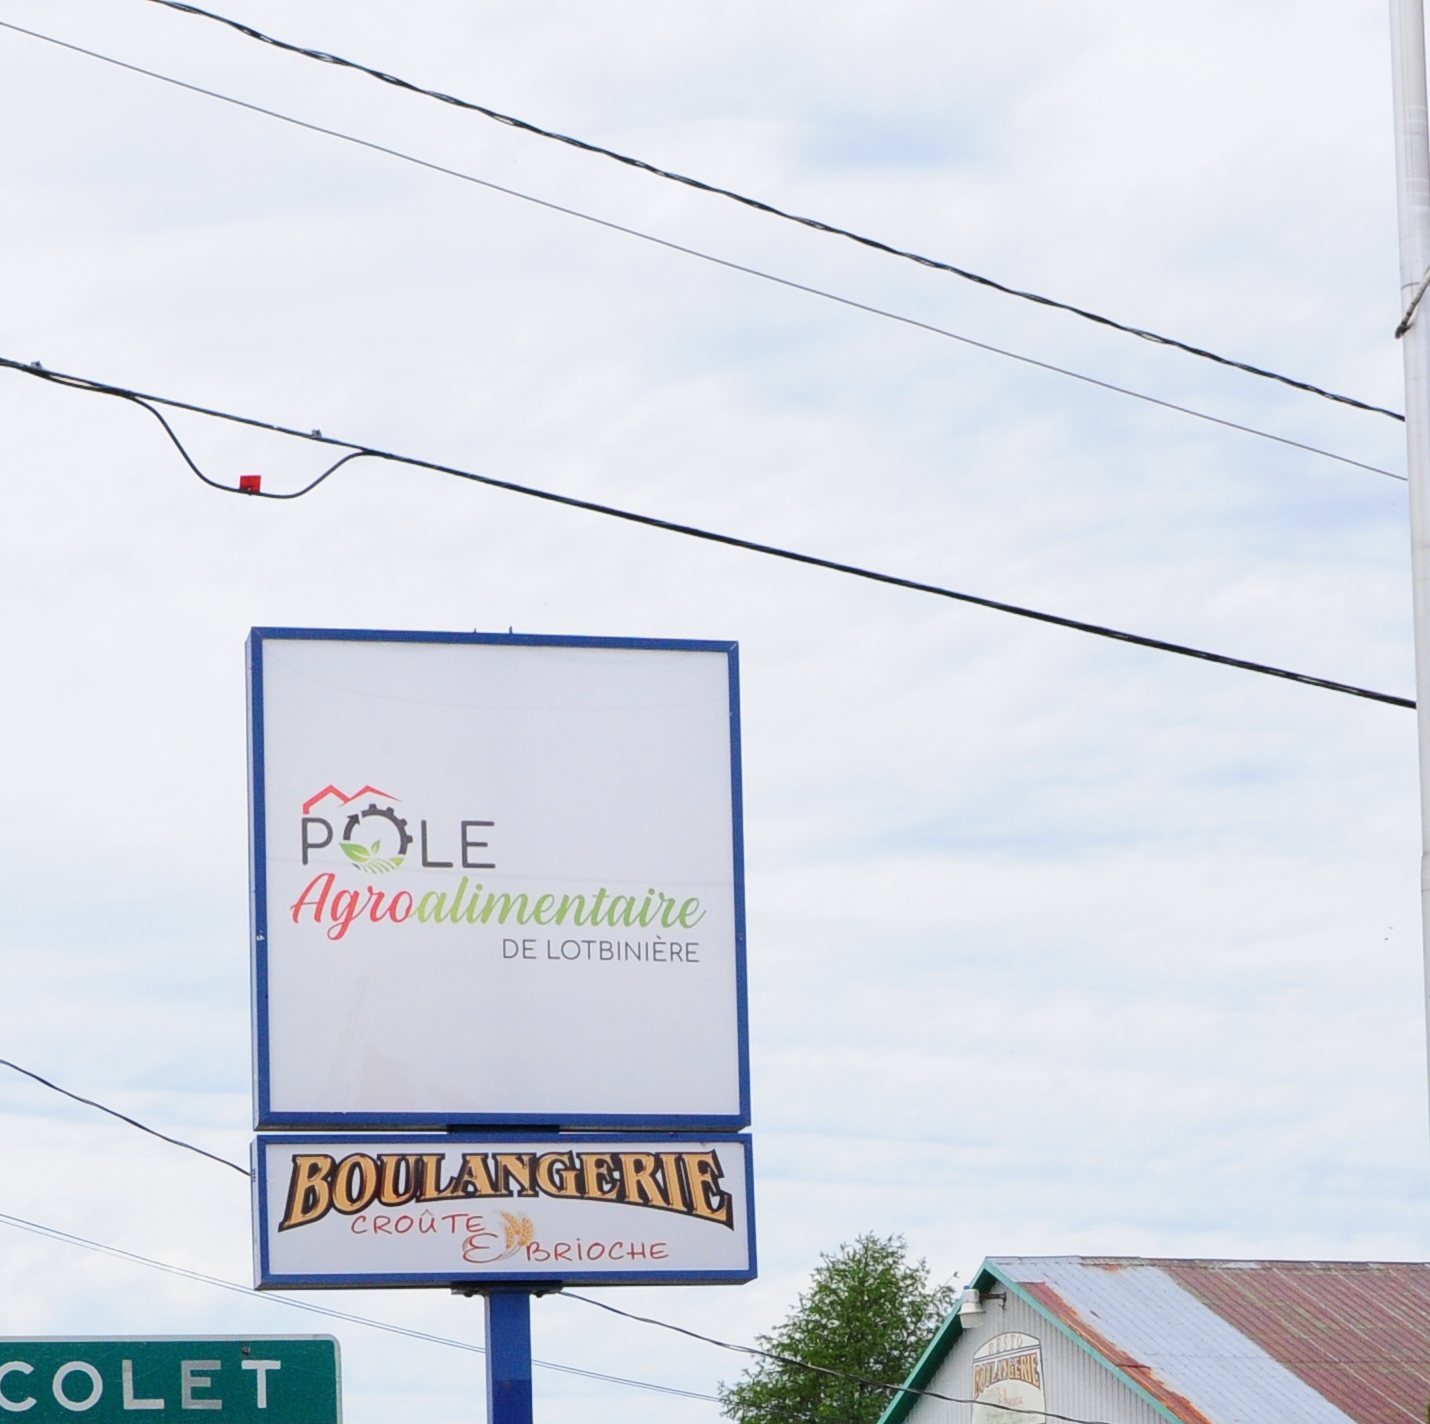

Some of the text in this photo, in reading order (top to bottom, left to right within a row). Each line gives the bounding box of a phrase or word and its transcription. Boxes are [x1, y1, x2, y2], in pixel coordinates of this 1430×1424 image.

[290, 872, 707, 941] Agroalimentaire
[502, 935, 700, 963] DE LOTBINIÈRE
[277, 1148, 735, 1232] BOULANGERIE
[350, 1209, 485, 1236] CROÛTE
[526, 1237, 669, 1263] BRIOCHE
[974, 1352, 1040, 1400] BOULANGERIE
